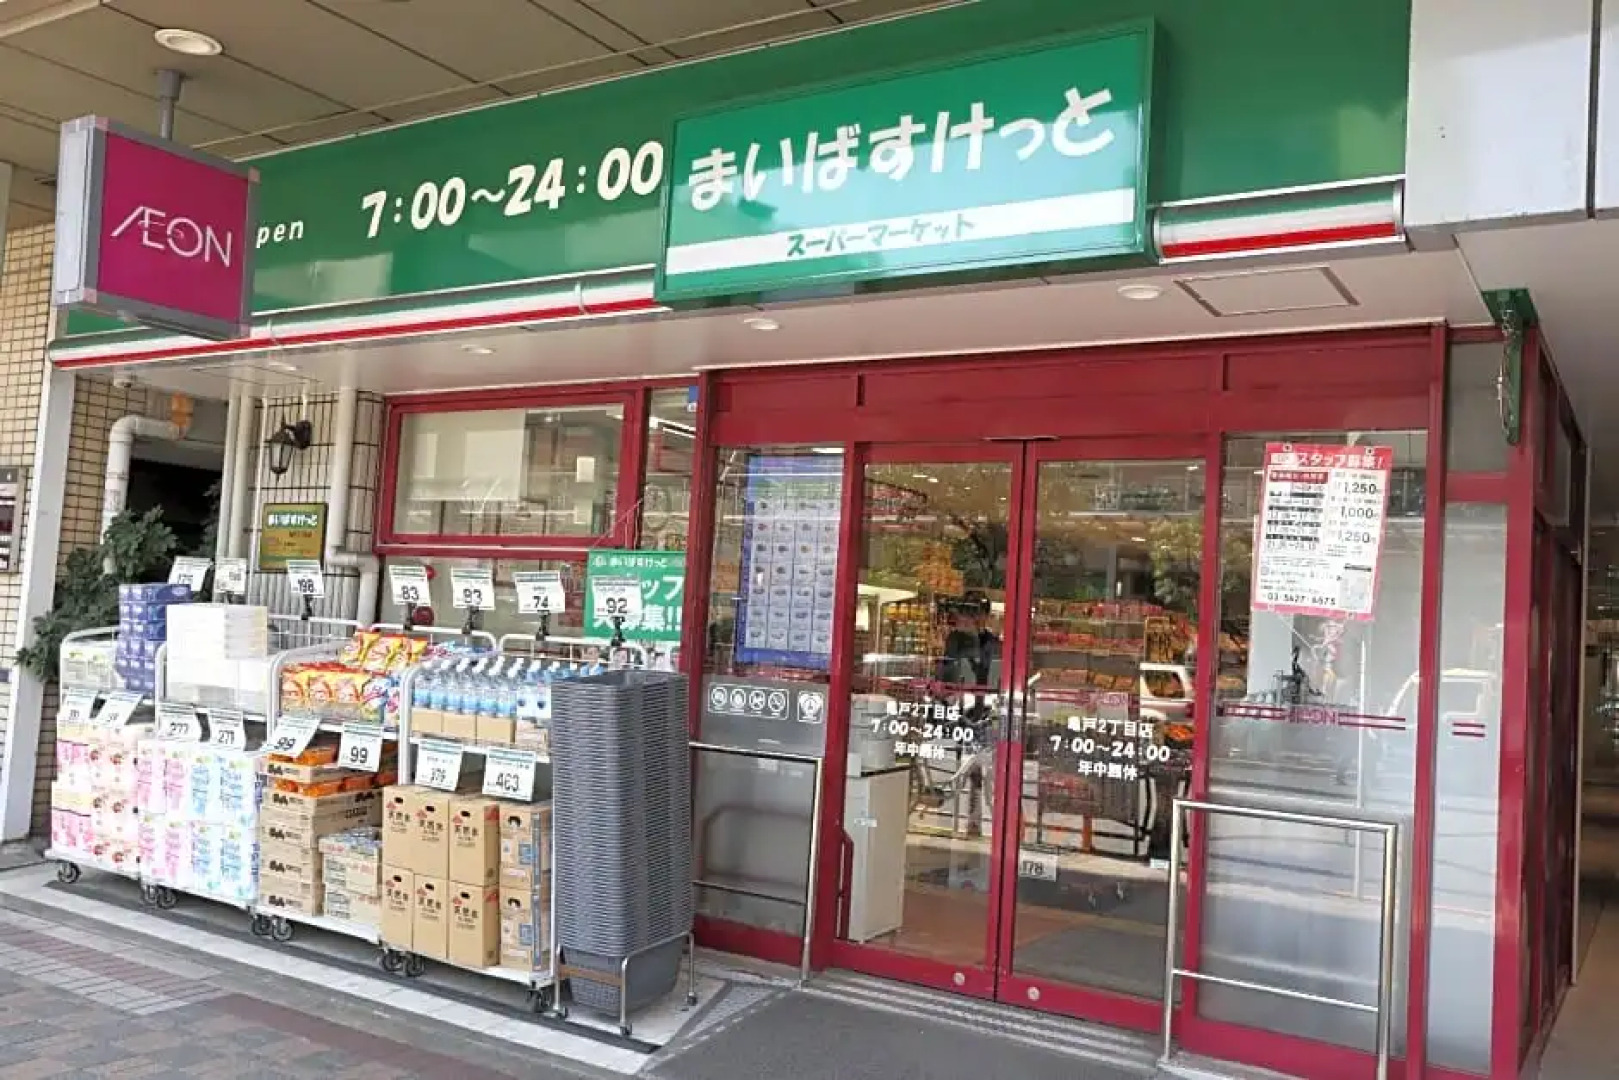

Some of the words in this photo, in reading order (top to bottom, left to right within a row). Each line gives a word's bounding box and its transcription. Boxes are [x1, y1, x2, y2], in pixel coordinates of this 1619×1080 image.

[688, 87, 1115, 211] まいばすけっと
[110, 206, 232, 267] AEON
[256, 219, 304, 248] pen
[786, 213, 976, 257] スーパーマーケット
[606, 597, 628, 614] 92
[350, 745, 368, 763] 99
